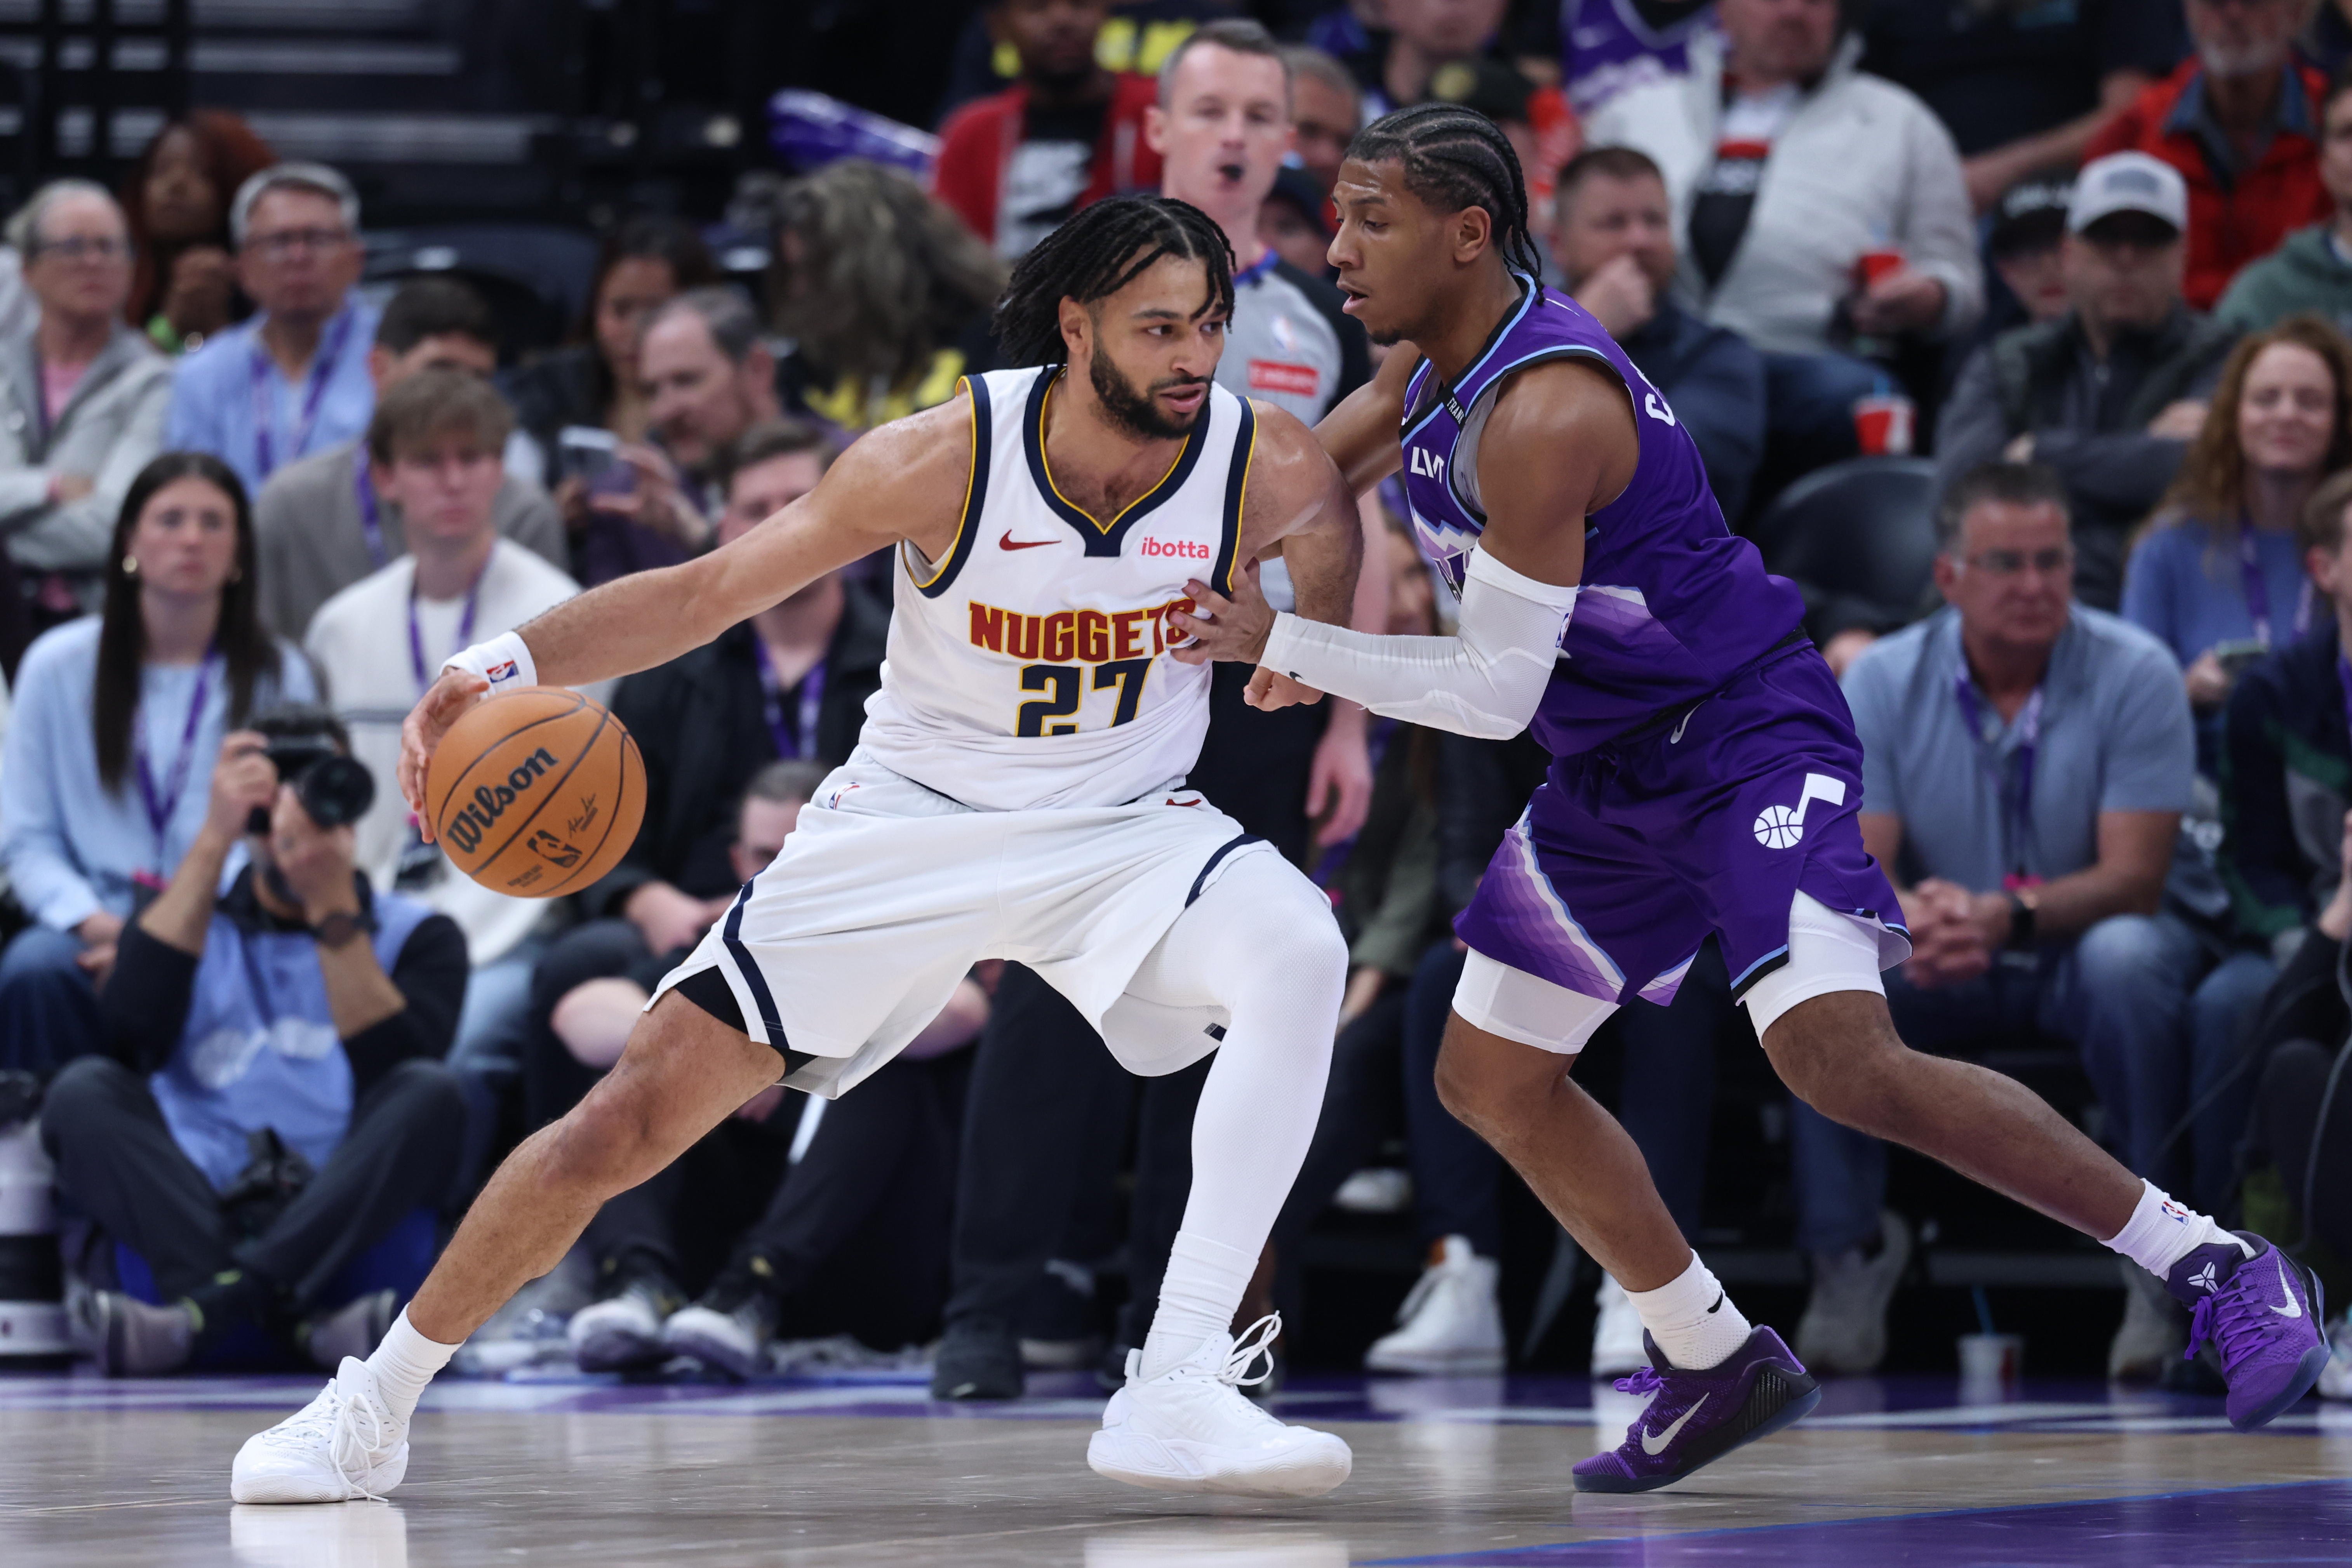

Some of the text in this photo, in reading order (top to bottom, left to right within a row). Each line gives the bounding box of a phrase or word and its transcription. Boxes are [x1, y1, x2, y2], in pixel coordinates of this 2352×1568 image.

[1141, 537, 1209, 559] ibotta
[1014, 658, 1155, 737] 27
[447, 747, 559, 854] Wilson
